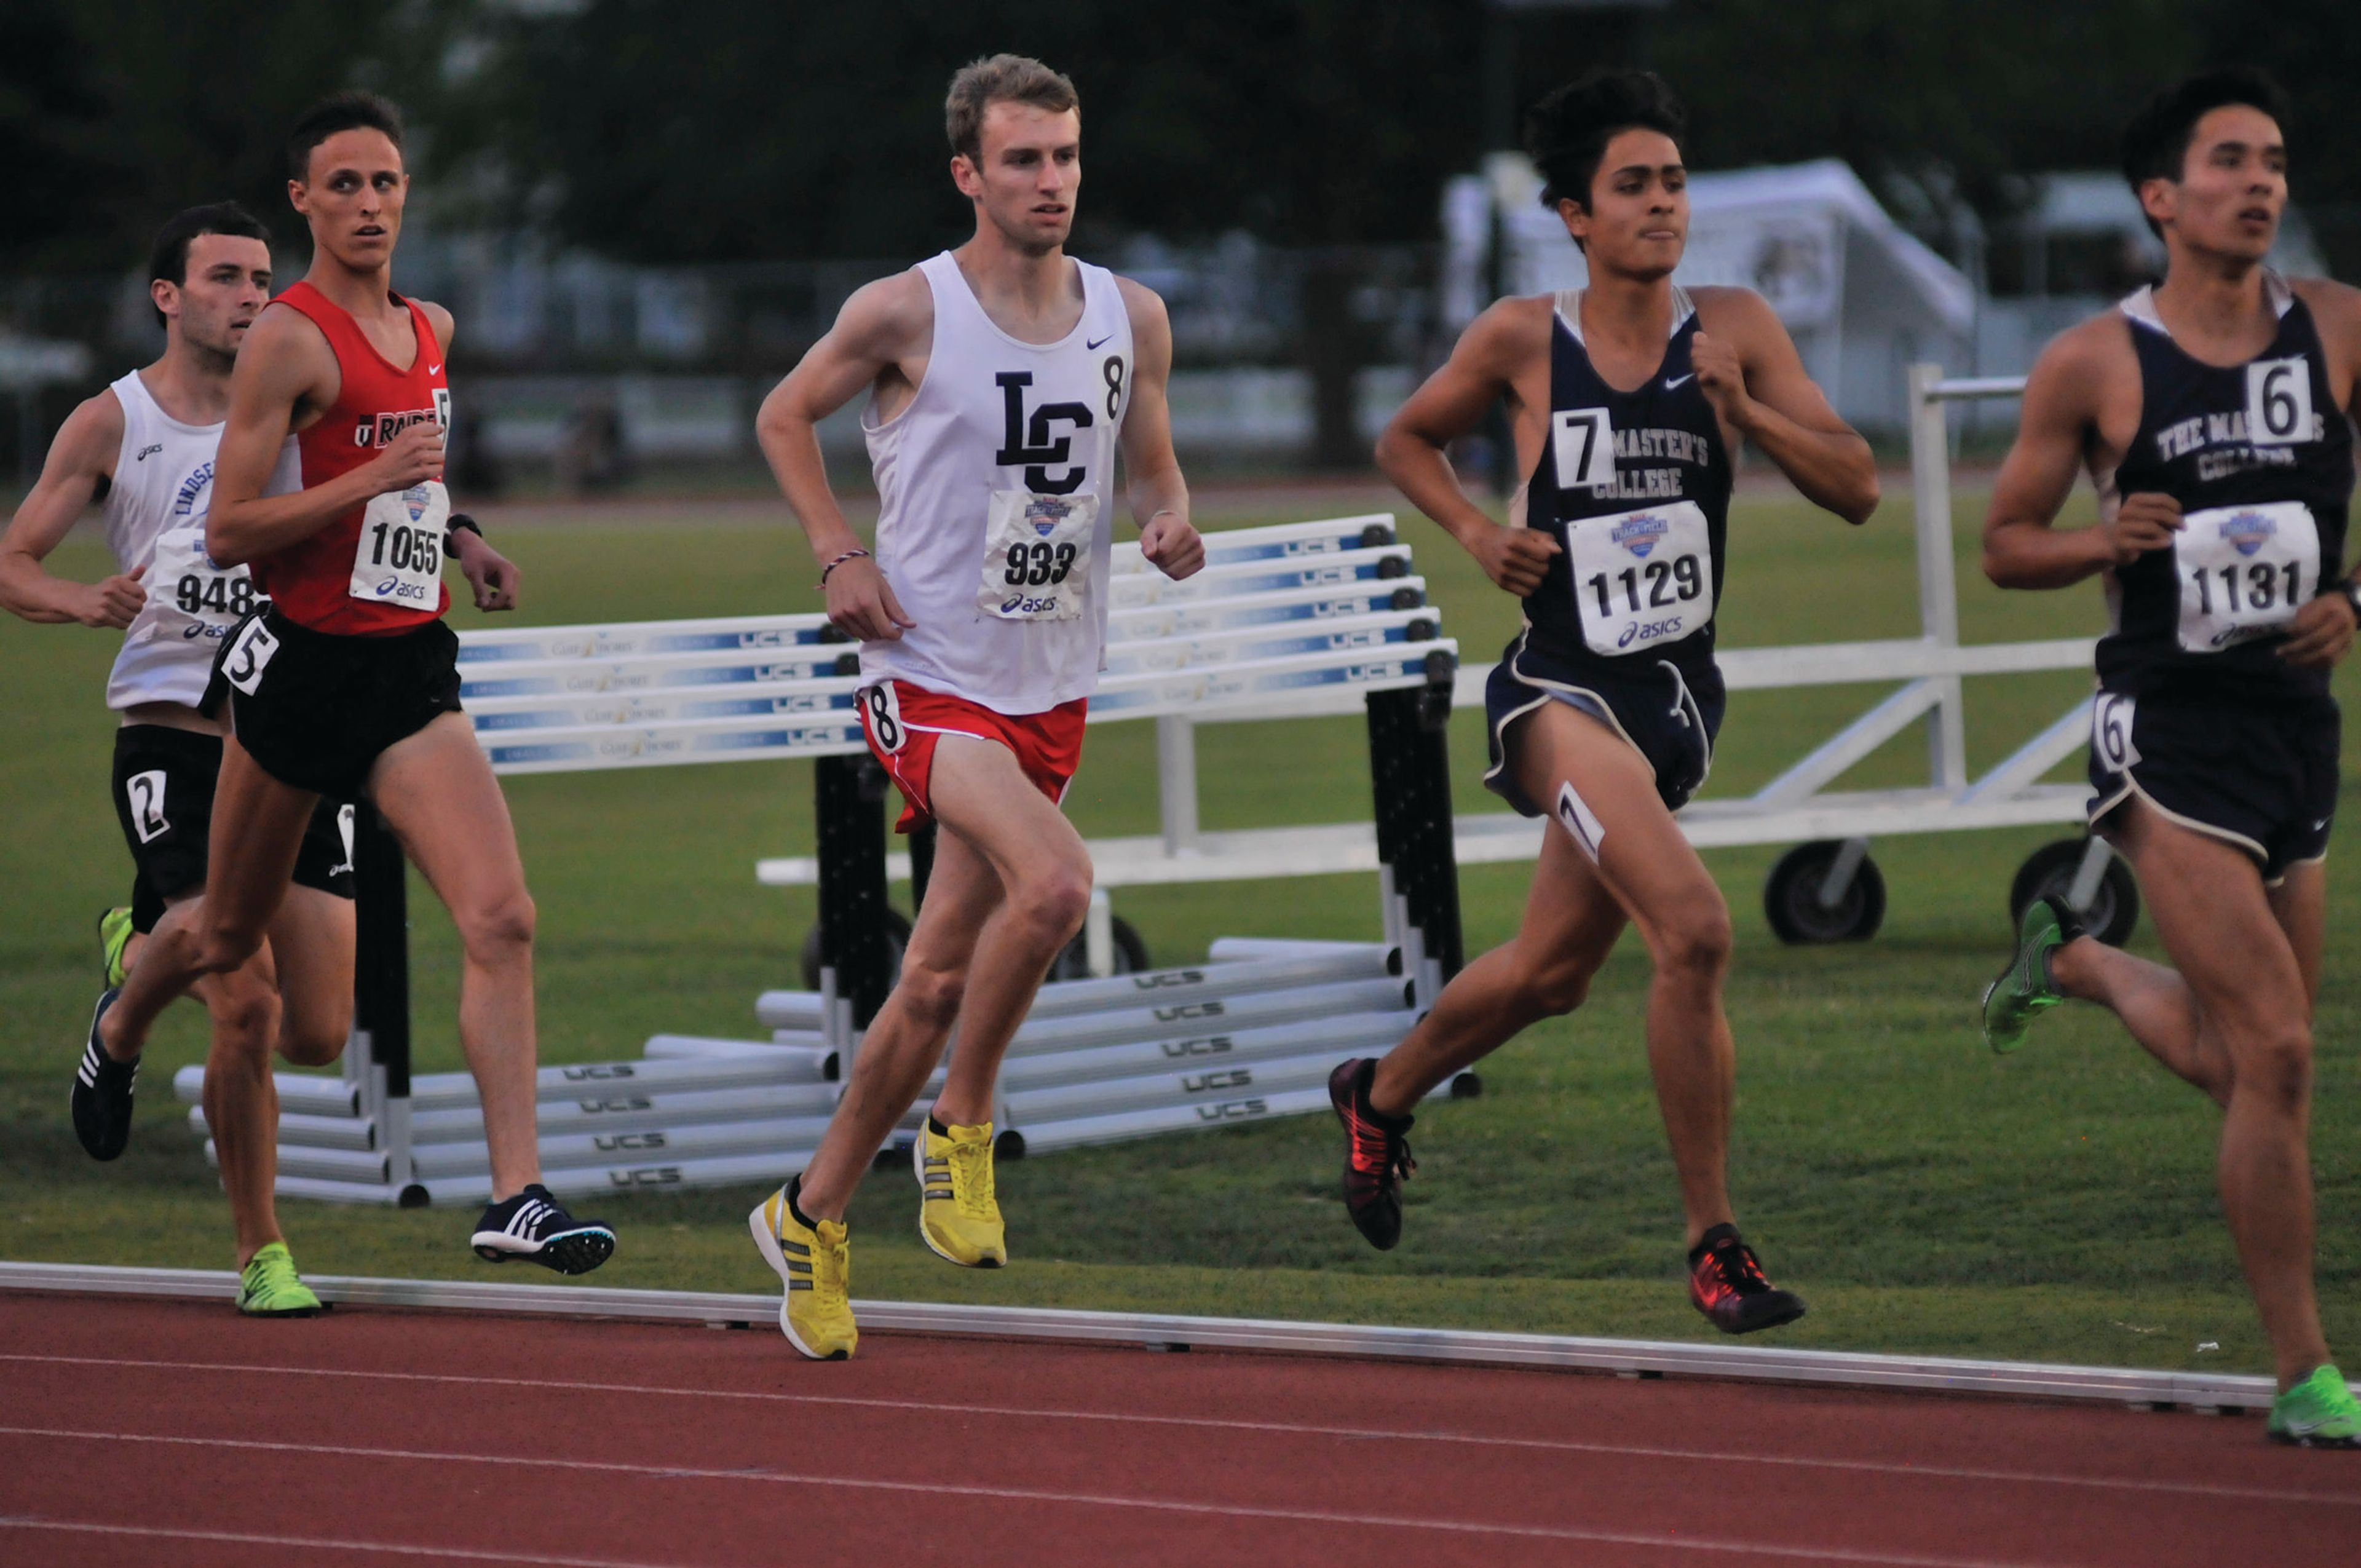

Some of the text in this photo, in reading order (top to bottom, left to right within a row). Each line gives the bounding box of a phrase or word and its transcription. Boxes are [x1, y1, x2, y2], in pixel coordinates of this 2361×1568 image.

[1104, 355, 1124, 421] 8
[2262, 366, 2298, 436] 6
[995, 371, 1093, 496] LC
[1566, 415, 1598, 482] 7
[1612, 428, 1709, 467] MASTER'S
[2157, 417, 2205, 462] THE
[175, 462, 215, 515] LINDSE
[372, 523, 438, 575] 1055
[1005, 542, 1076, 586] 933
[176, 574, 255, 617] 948
[397, 583, 424, 600] asics
[1589, 554, 1703, 618] 1129
[2193, 561, 2301, 616] 1131
[1640, 617, 1682, 640] asics
[231, 627, 269, 682] 5
[870, 684, 897, 749] 8
[2103, 695, 2126, 765] 6
[134, 776, 165, 834] 2
[1134, 972, 1204, 989] UCS
[1153, 1002, 1224, 1021] UCS
[1162, 1037, 1232, 1056] UCS
[563, 1066, 635, 1080] UCS
[1182, 1069, 1252, 1092] UCS
[579, 1099, 651, 1113] UCS
[1196, 1099, 1268, 1120] UCS
[593, 1133, 665, 1150] UCS
[609, 1168, 681, 1186] UCS
